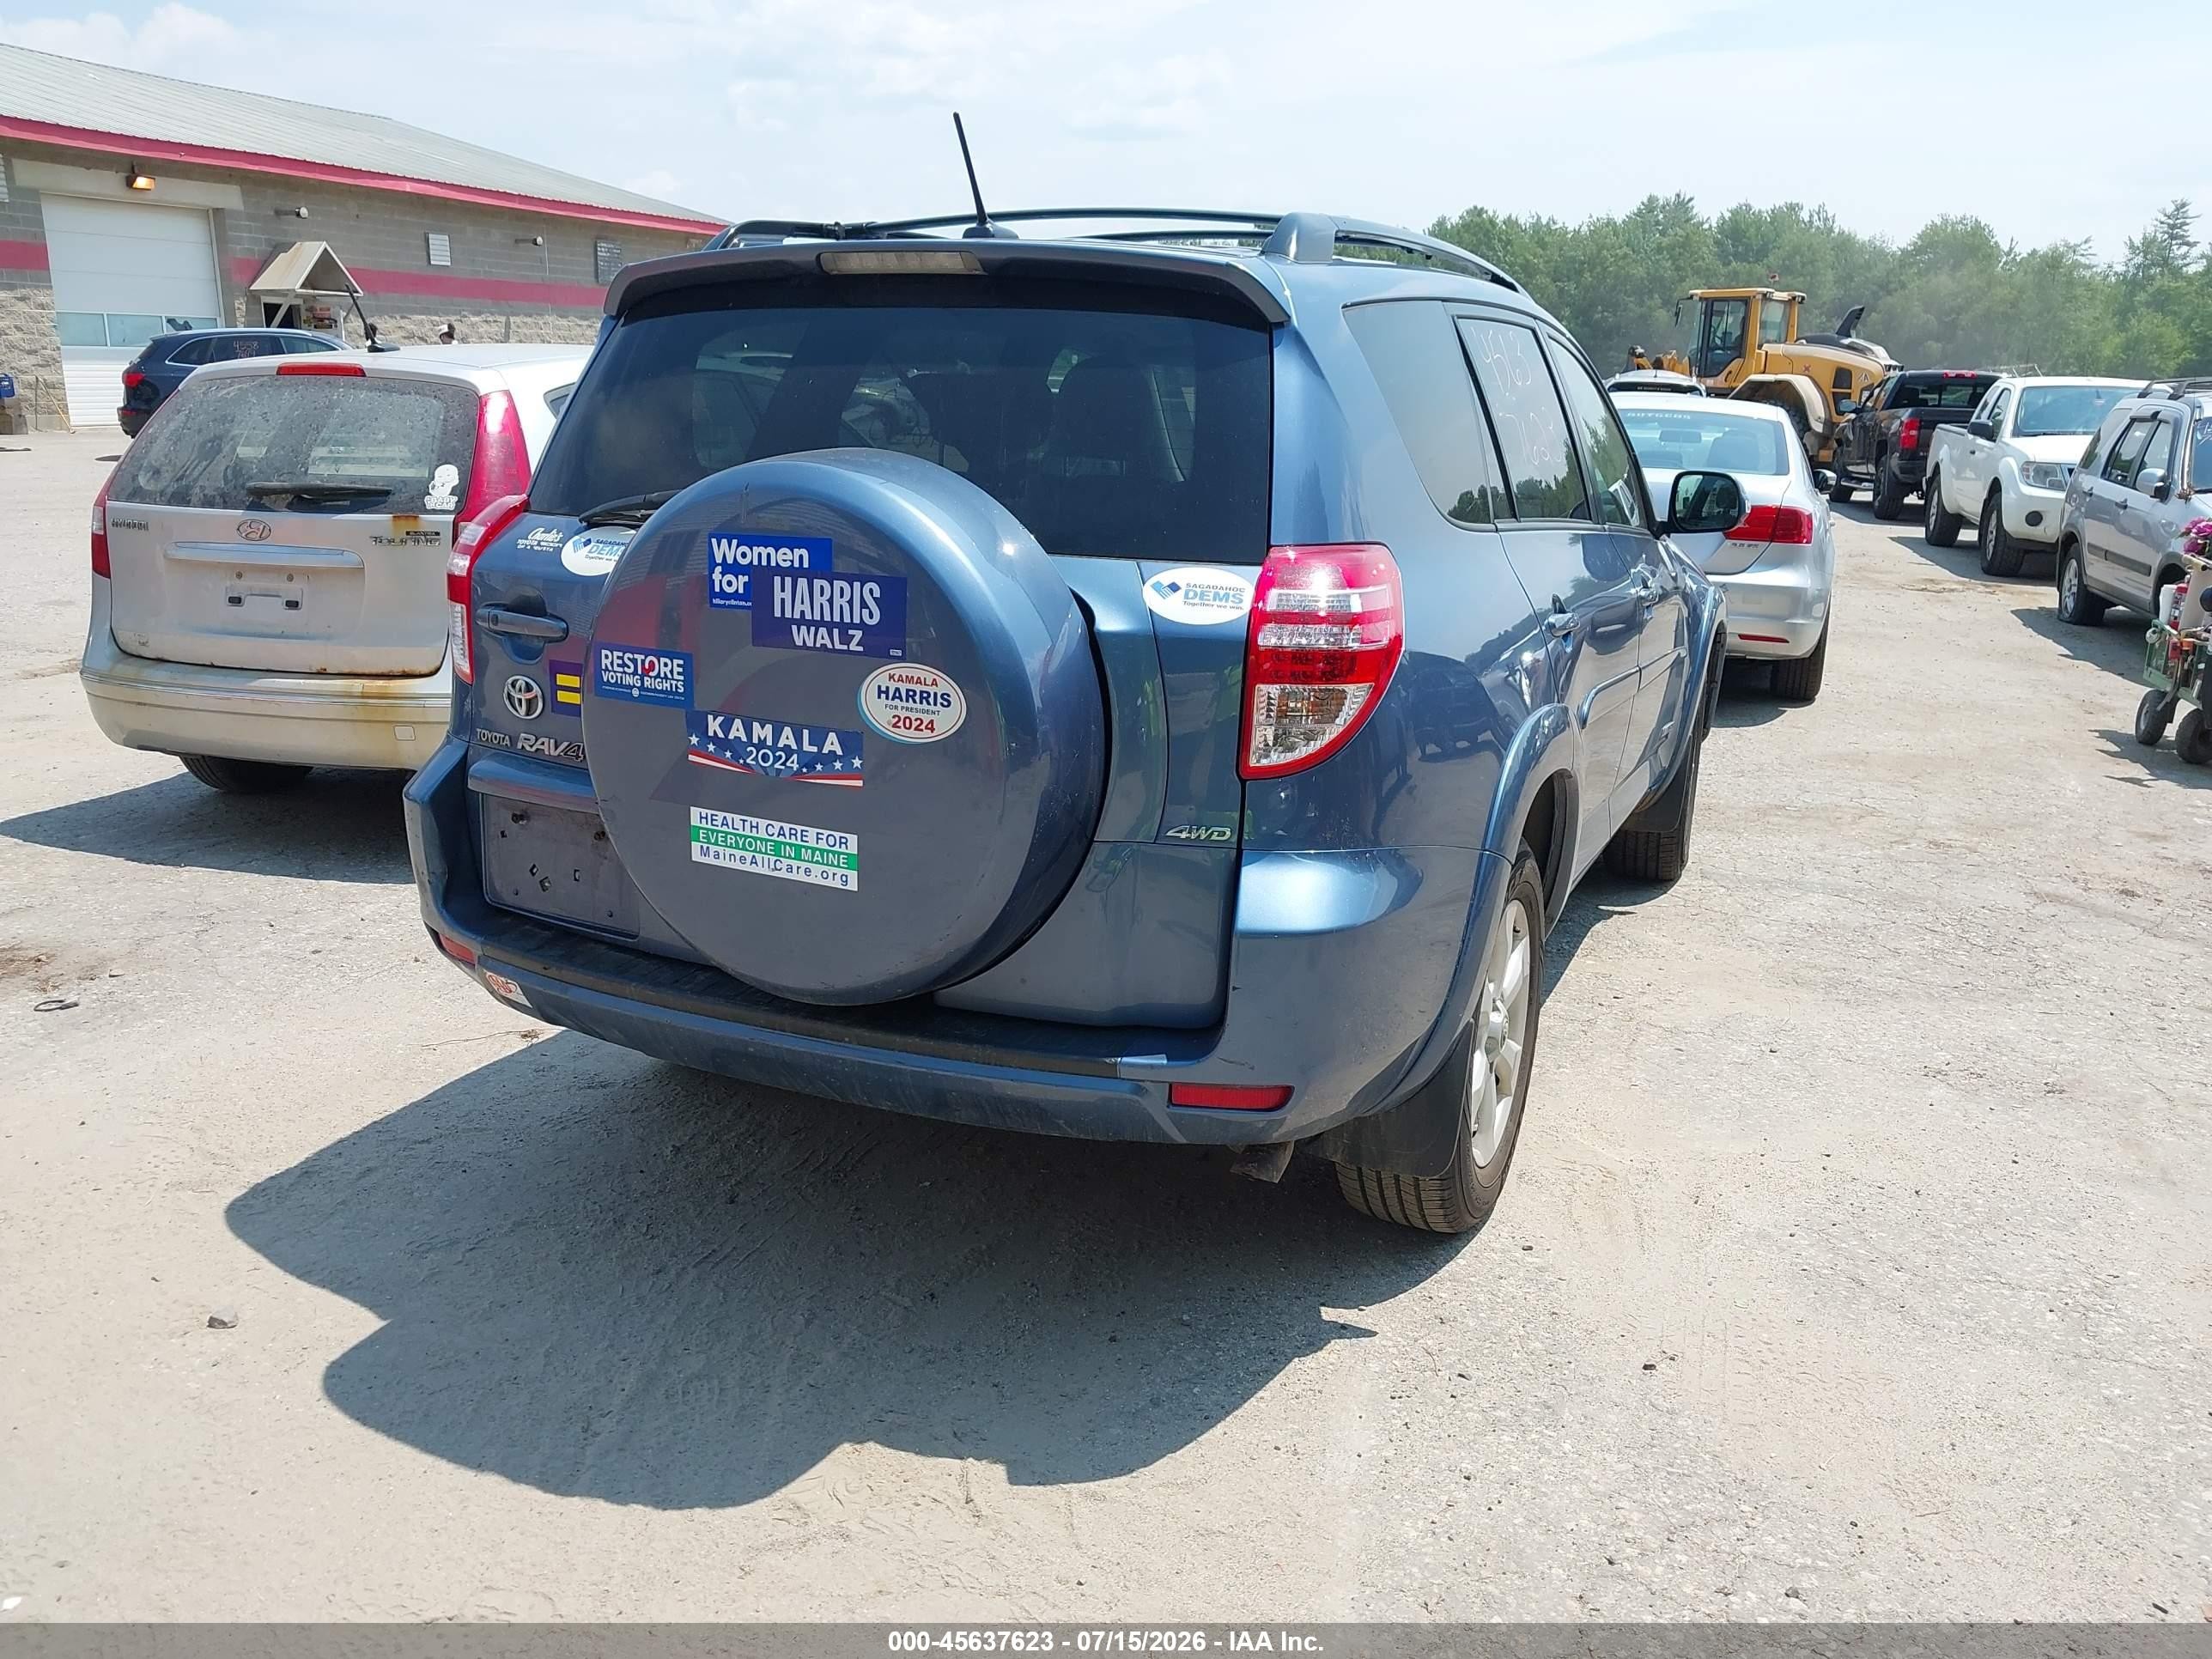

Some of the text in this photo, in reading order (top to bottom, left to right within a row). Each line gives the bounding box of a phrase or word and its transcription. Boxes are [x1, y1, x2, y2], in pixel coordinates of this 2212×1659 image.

[587, 544, 620, 557] DEM
[711, 538, 809, 568] Women
[712, 566, 748, 593] for
[1186, 583, 1246, 592] SAGADAHOC
[774, 576, 881, 625] HARRIS
[1183, 588, 1244, 605] DEMS
[791, 624, 864, 652] WALZ
[601, 649, 684, 680] RESTORE
[601, 670, 641, 687] VOTING
[643, 677, 684, 693] RIGHTS
[888, 672, 939, 688] KAMALA
[877, 684, 952, 708] HARRIS
[884, 703, 941, 716] FOR PRESIDENT
[707, 714, 843, 756] KAMALA
[891, 714, 936, 733] 2024
[476, 728, 585, 763] TOYOTA RAV4
[745, 746, 799, 771] 2024
[699, 811, 849, 850] HEALTH CARE FOR
[1165, 825, 1232, 841] 4WD
[699, 829, 848, 868] EVERYONE IN MAINE
[700, 845, 849, 887] MaineAllCare.org
